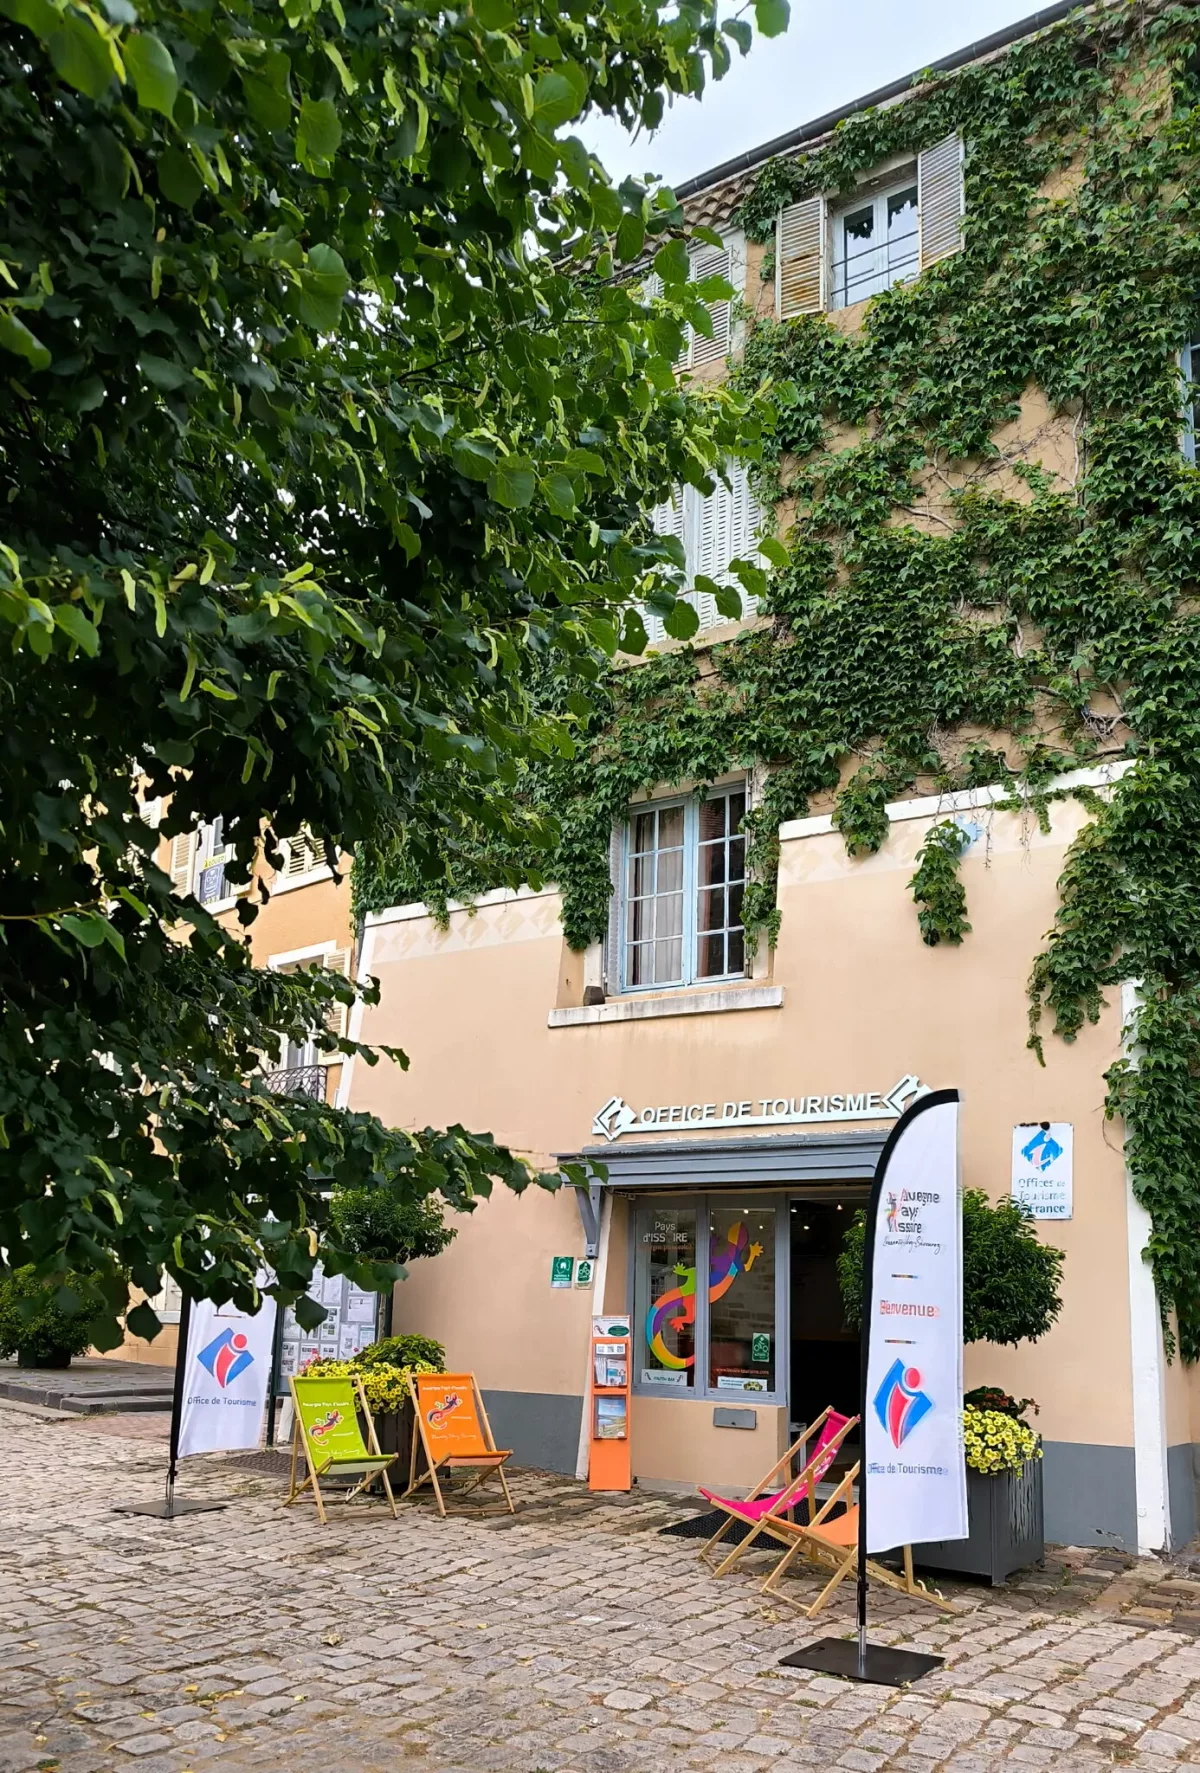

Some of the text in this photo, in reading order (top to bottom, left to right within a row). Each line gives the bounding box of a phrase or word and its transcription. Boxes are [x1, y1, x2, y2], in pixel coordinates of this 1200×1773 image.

[640, 1091, 881, 1124] OFFICE DE TOURISME
[1018, 1177, 1054, 1188] Offices
[1018, 1190, 1066, 1201] Tourisme
[654, 1221, 676, 1233] Pays
[187, 1396, 257, 1407] Office de Tourisme
[887, 1462, 896, 1474] de
[897, 1462, 943, 1475] Tourisme
